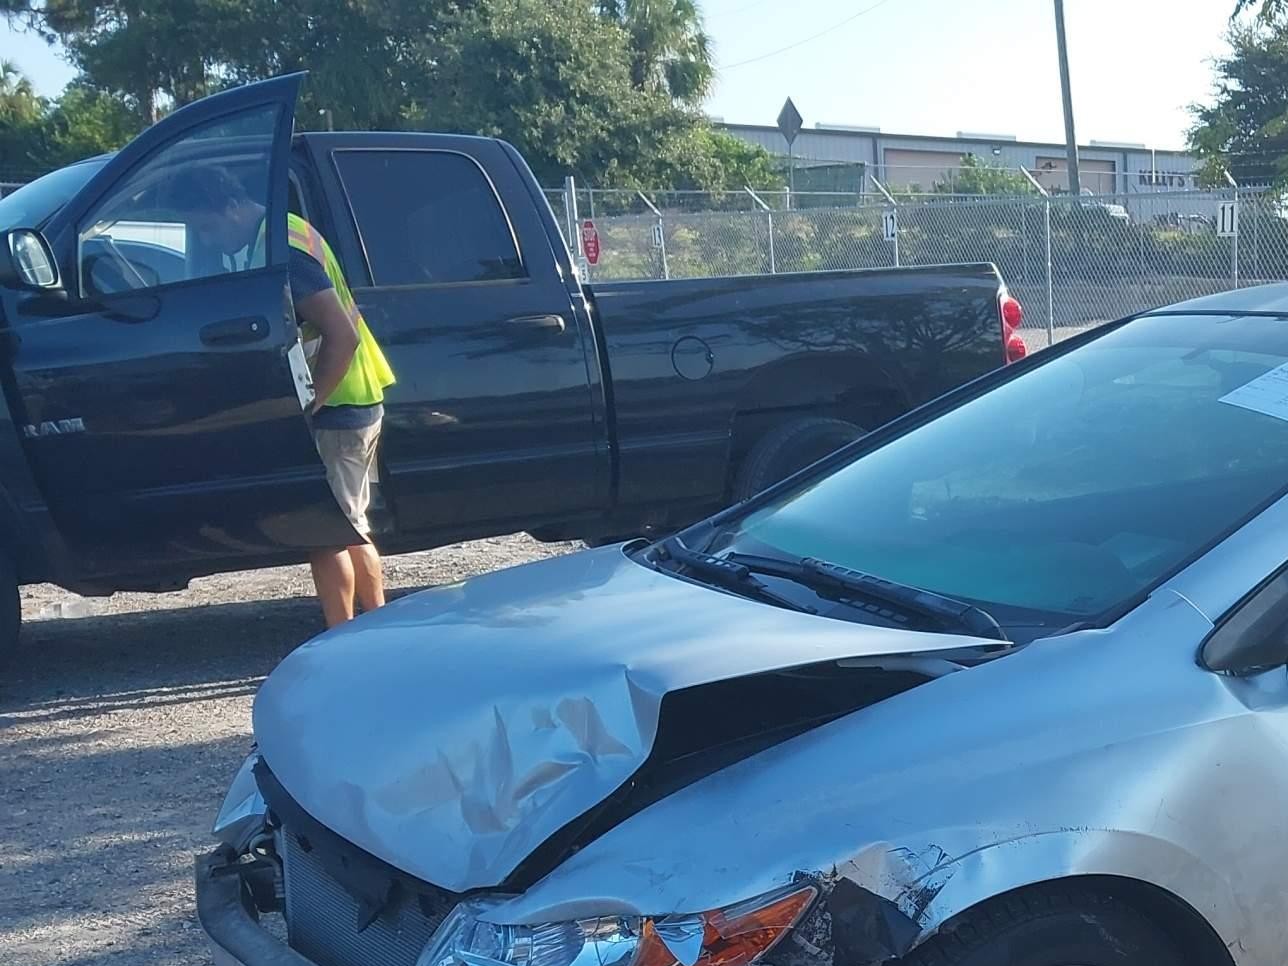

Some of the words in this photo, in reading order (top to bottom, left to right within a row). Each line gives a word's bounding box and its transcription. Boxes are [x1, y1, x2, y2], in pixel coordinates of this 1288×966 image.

[884, 214, 896, 238] 12
[1220, 204, 1235, 233] 11
[23, 417, 86, 438] RAM
